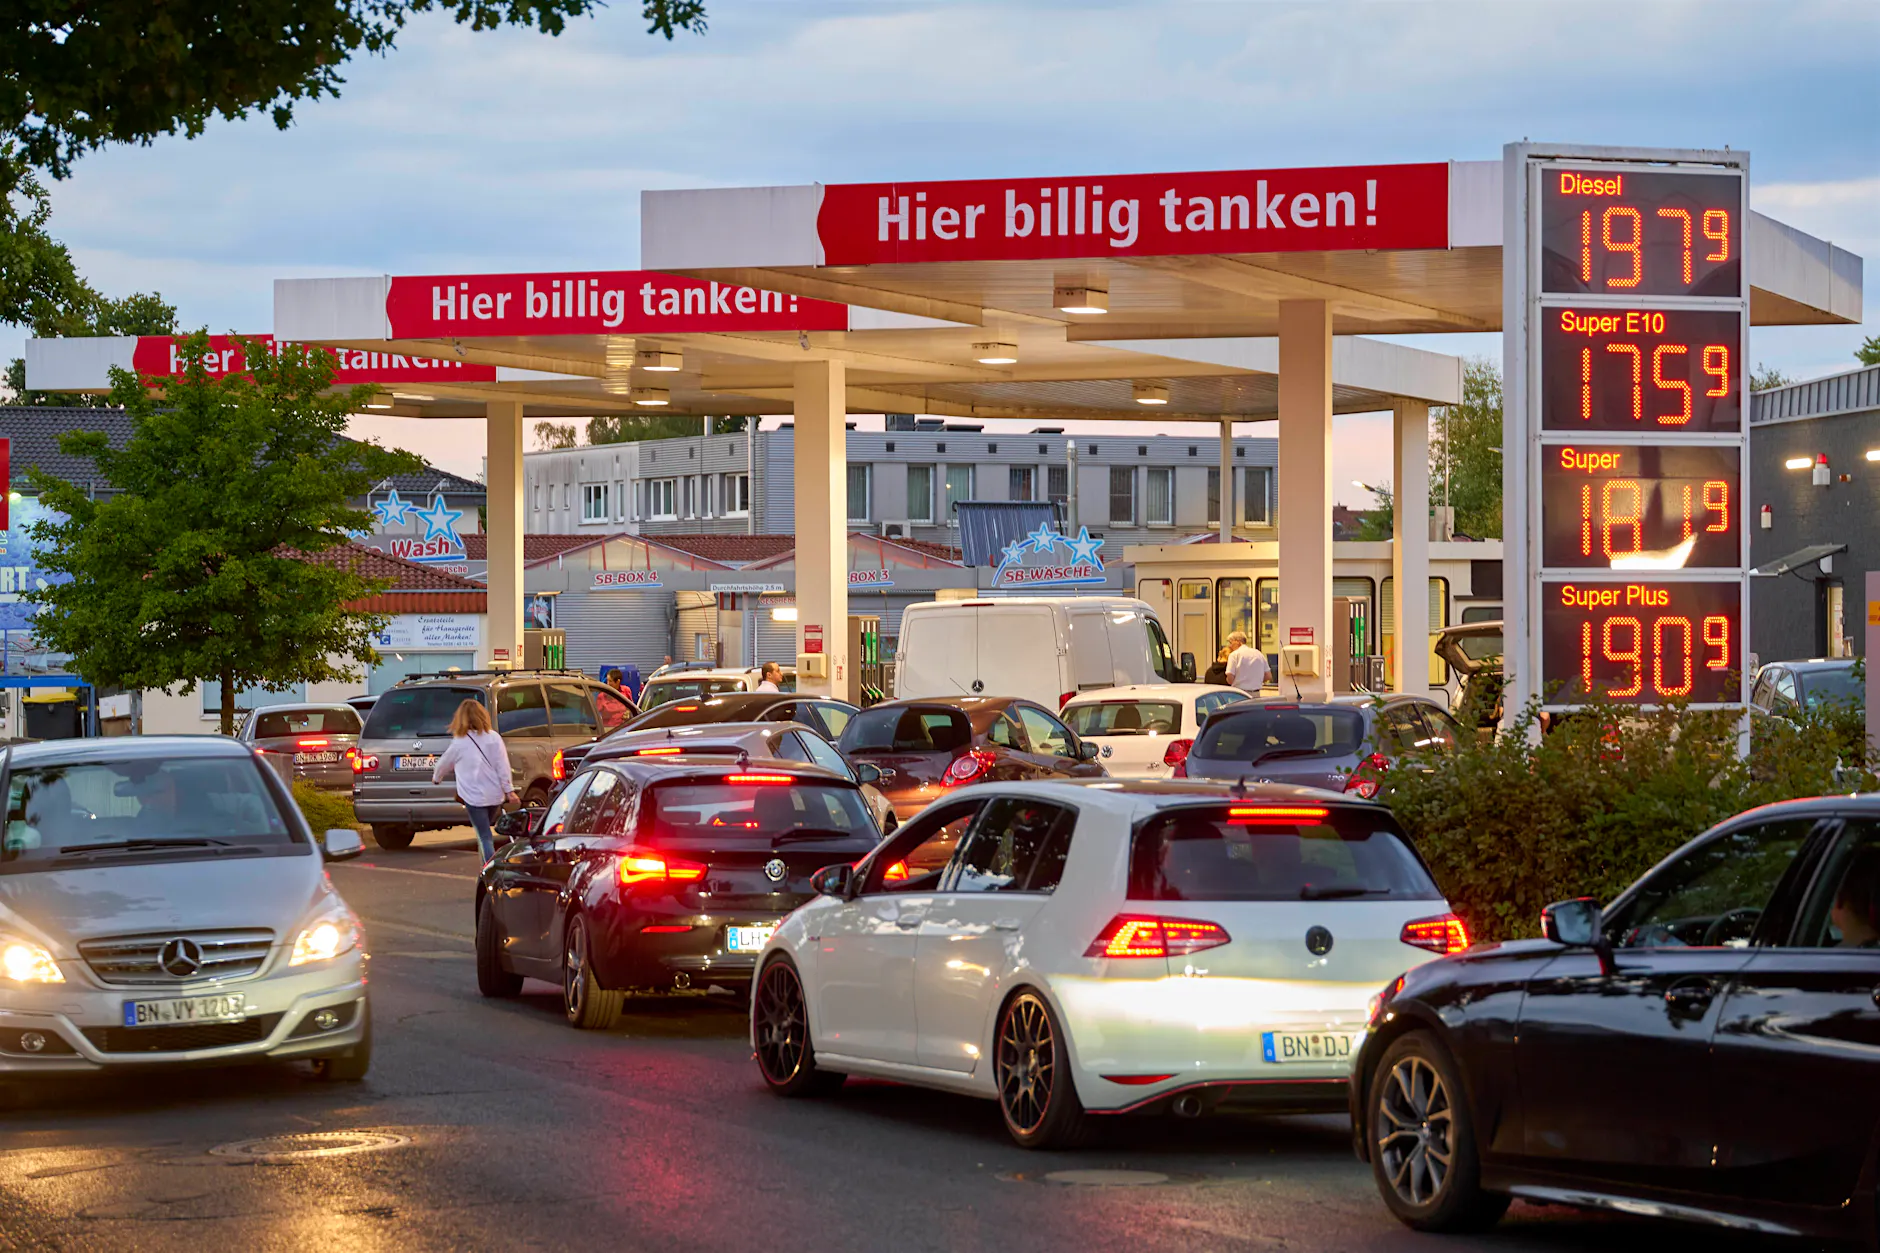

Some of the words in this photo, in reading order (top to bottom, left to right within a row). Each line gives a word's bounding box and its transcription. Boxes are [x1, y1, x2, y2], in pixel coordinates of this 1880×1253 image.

[1560, 173, 1622, 196] Diesel
[877, 192, 985, 241] Hier
[1005, 185, 1139, 248] billig
[1159, 179, 1378, 232] tanken!
[432, 282, 511, 321] Hier
[525, 279, 625, 328] billig
[1560, 310, 1621, 337] Super
[1626, 312, 1665, 335] E10
[169, 344, 235, 373] Her
[1560, 447, 1621, 474] Super
[390, 536, 452, 558] Wash
[595, 571, 645, 585] SB-BOX
[648, 570, 658, 582] 4
[880, 568, 890, 581] 3
[1004, 565, 1092, 583] SB-WÄSCHE
[1560, 584, 1621, 611] Super
[1626, 584, 1669, 606] Plus
[295, 754, 305, 762] BN
[402, 757, 413, 767] BN
[137, 1003, 160, 1024] BN
[172, 1001, 194, 1020] VY
[1282, 1035, 1311, 1057] BN
[1323, 1035, 1350, 1057] DJ
